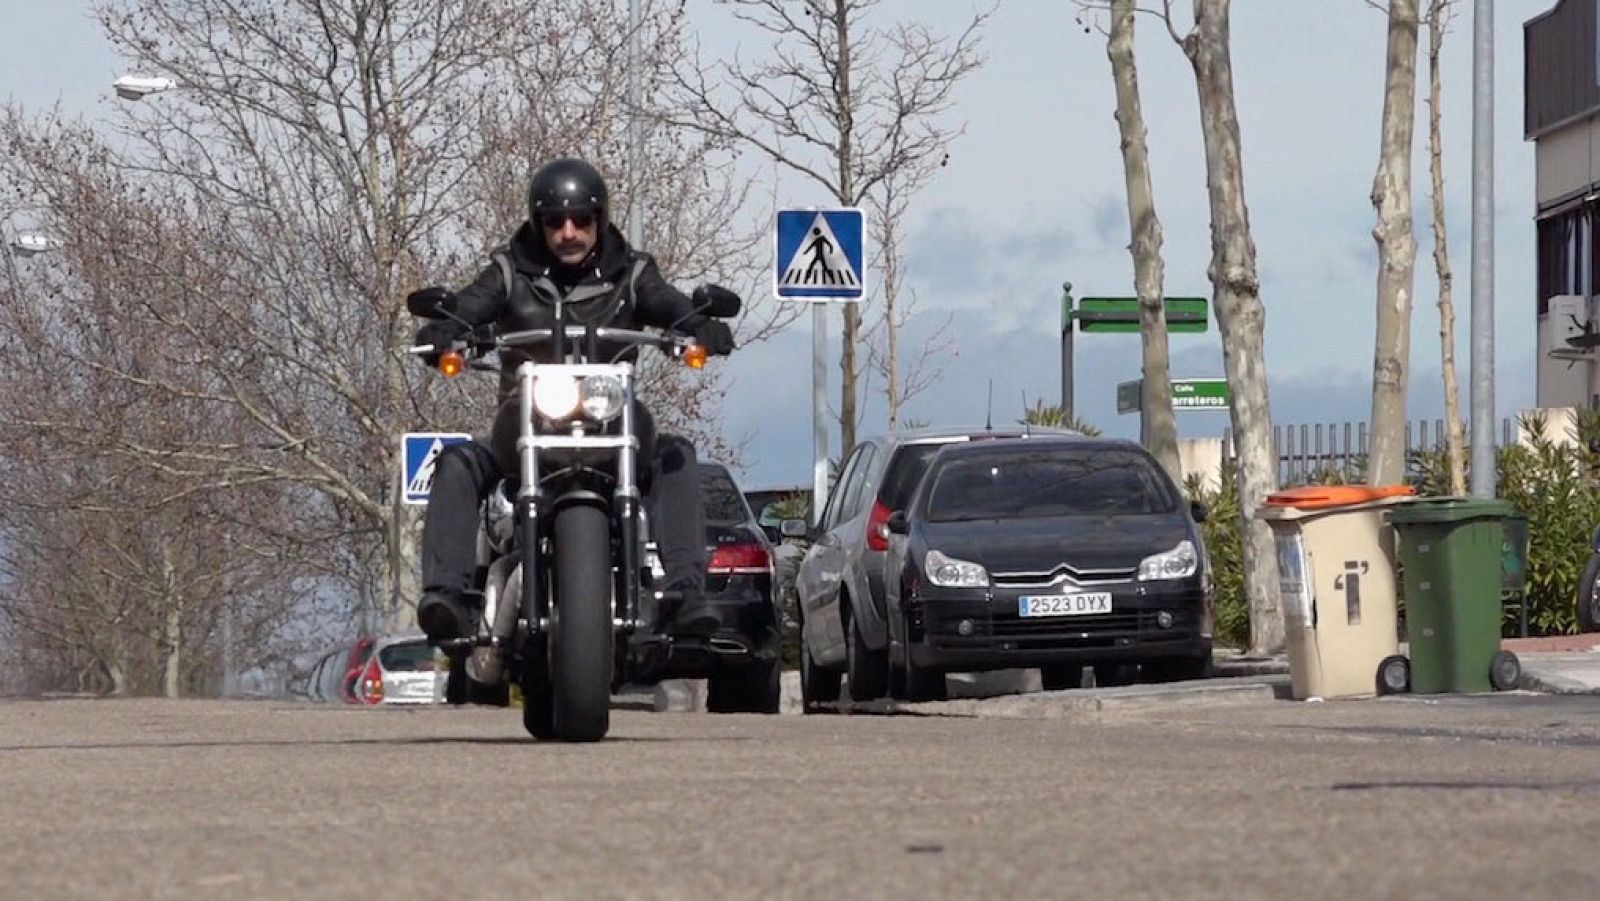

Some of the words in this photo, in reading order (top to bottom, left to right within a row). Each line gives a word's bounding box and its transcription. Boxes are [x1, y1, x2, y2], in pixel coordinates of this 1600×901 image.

[1171, 396, 1225, 406] arreteros
[1031, 597, 1072, 614] 2523
[1076, 596, 1107, 611] DYX
